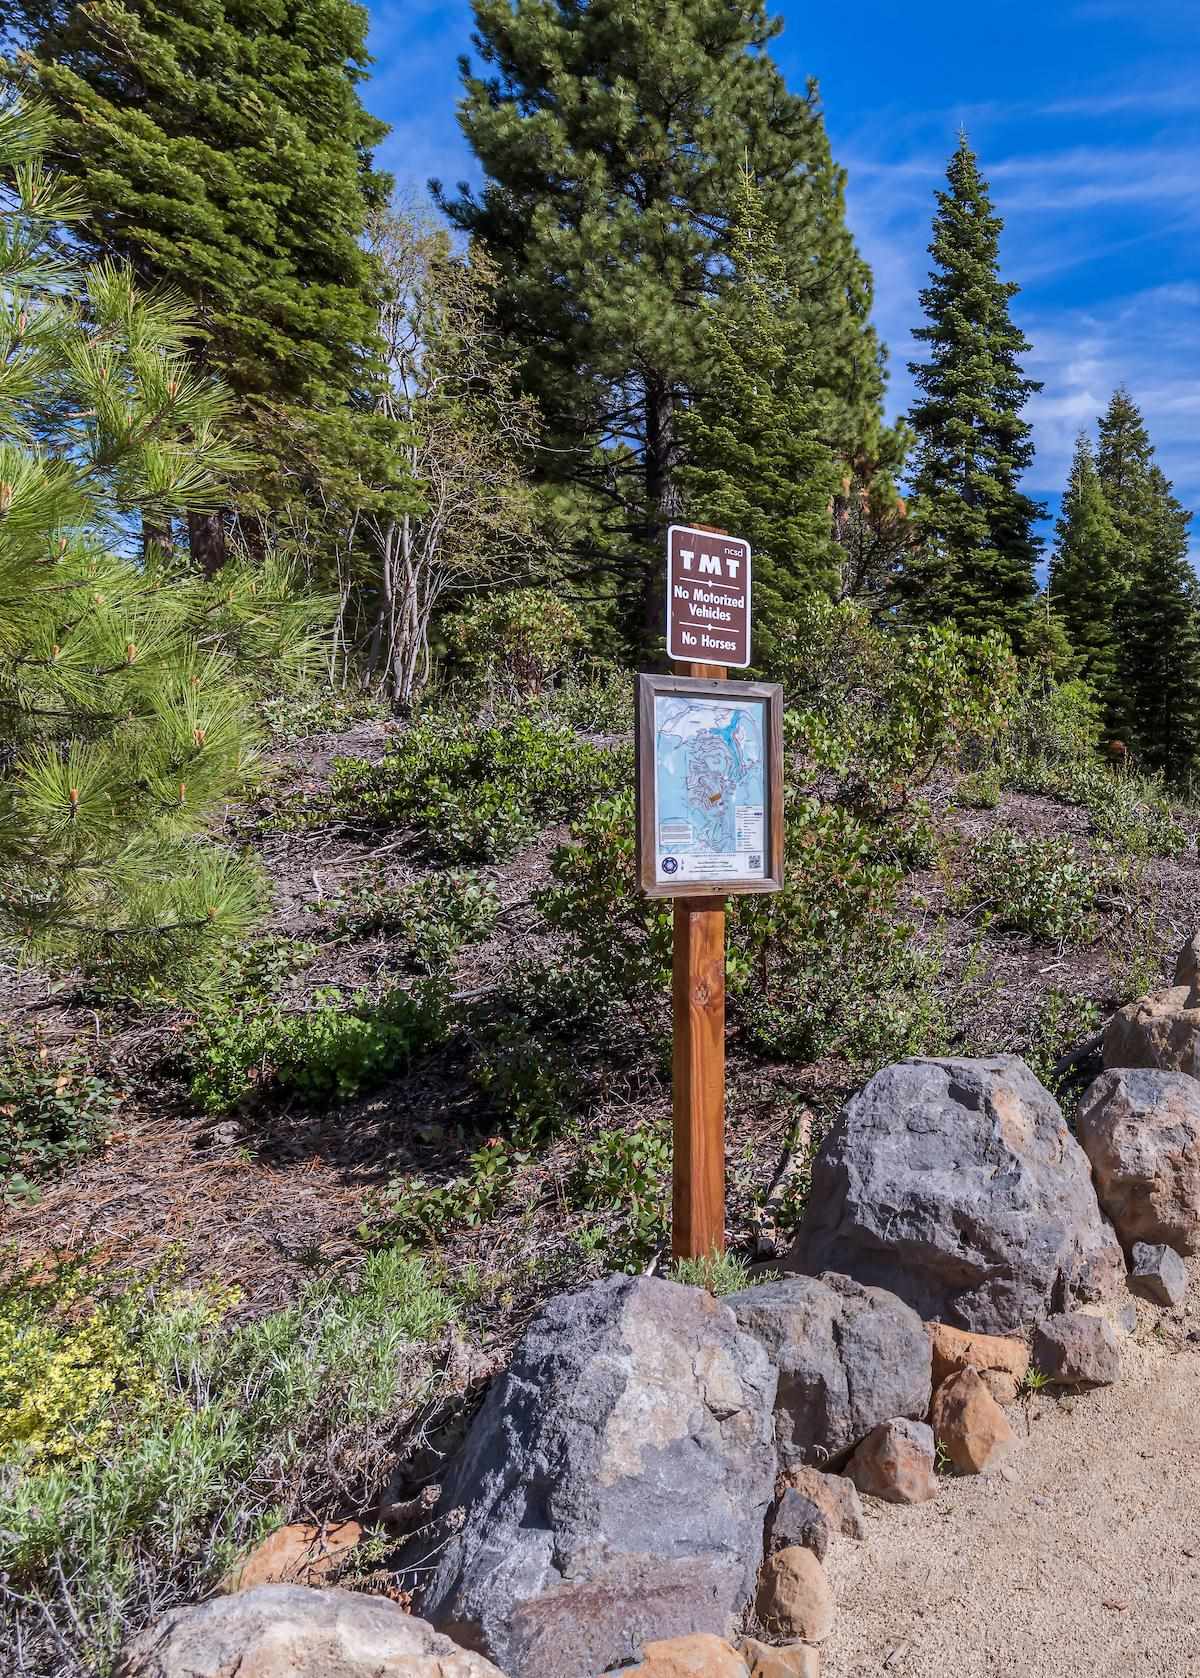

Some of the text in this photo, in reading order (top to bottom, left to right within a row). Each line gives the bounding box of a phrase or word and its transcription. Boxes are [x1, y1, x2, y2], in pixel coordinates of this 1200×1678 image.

[674, 585, 745, 609] No Motorized
[689, 603, 731, 622] Vehicles
[682, 631, 737, 651] No Horses
